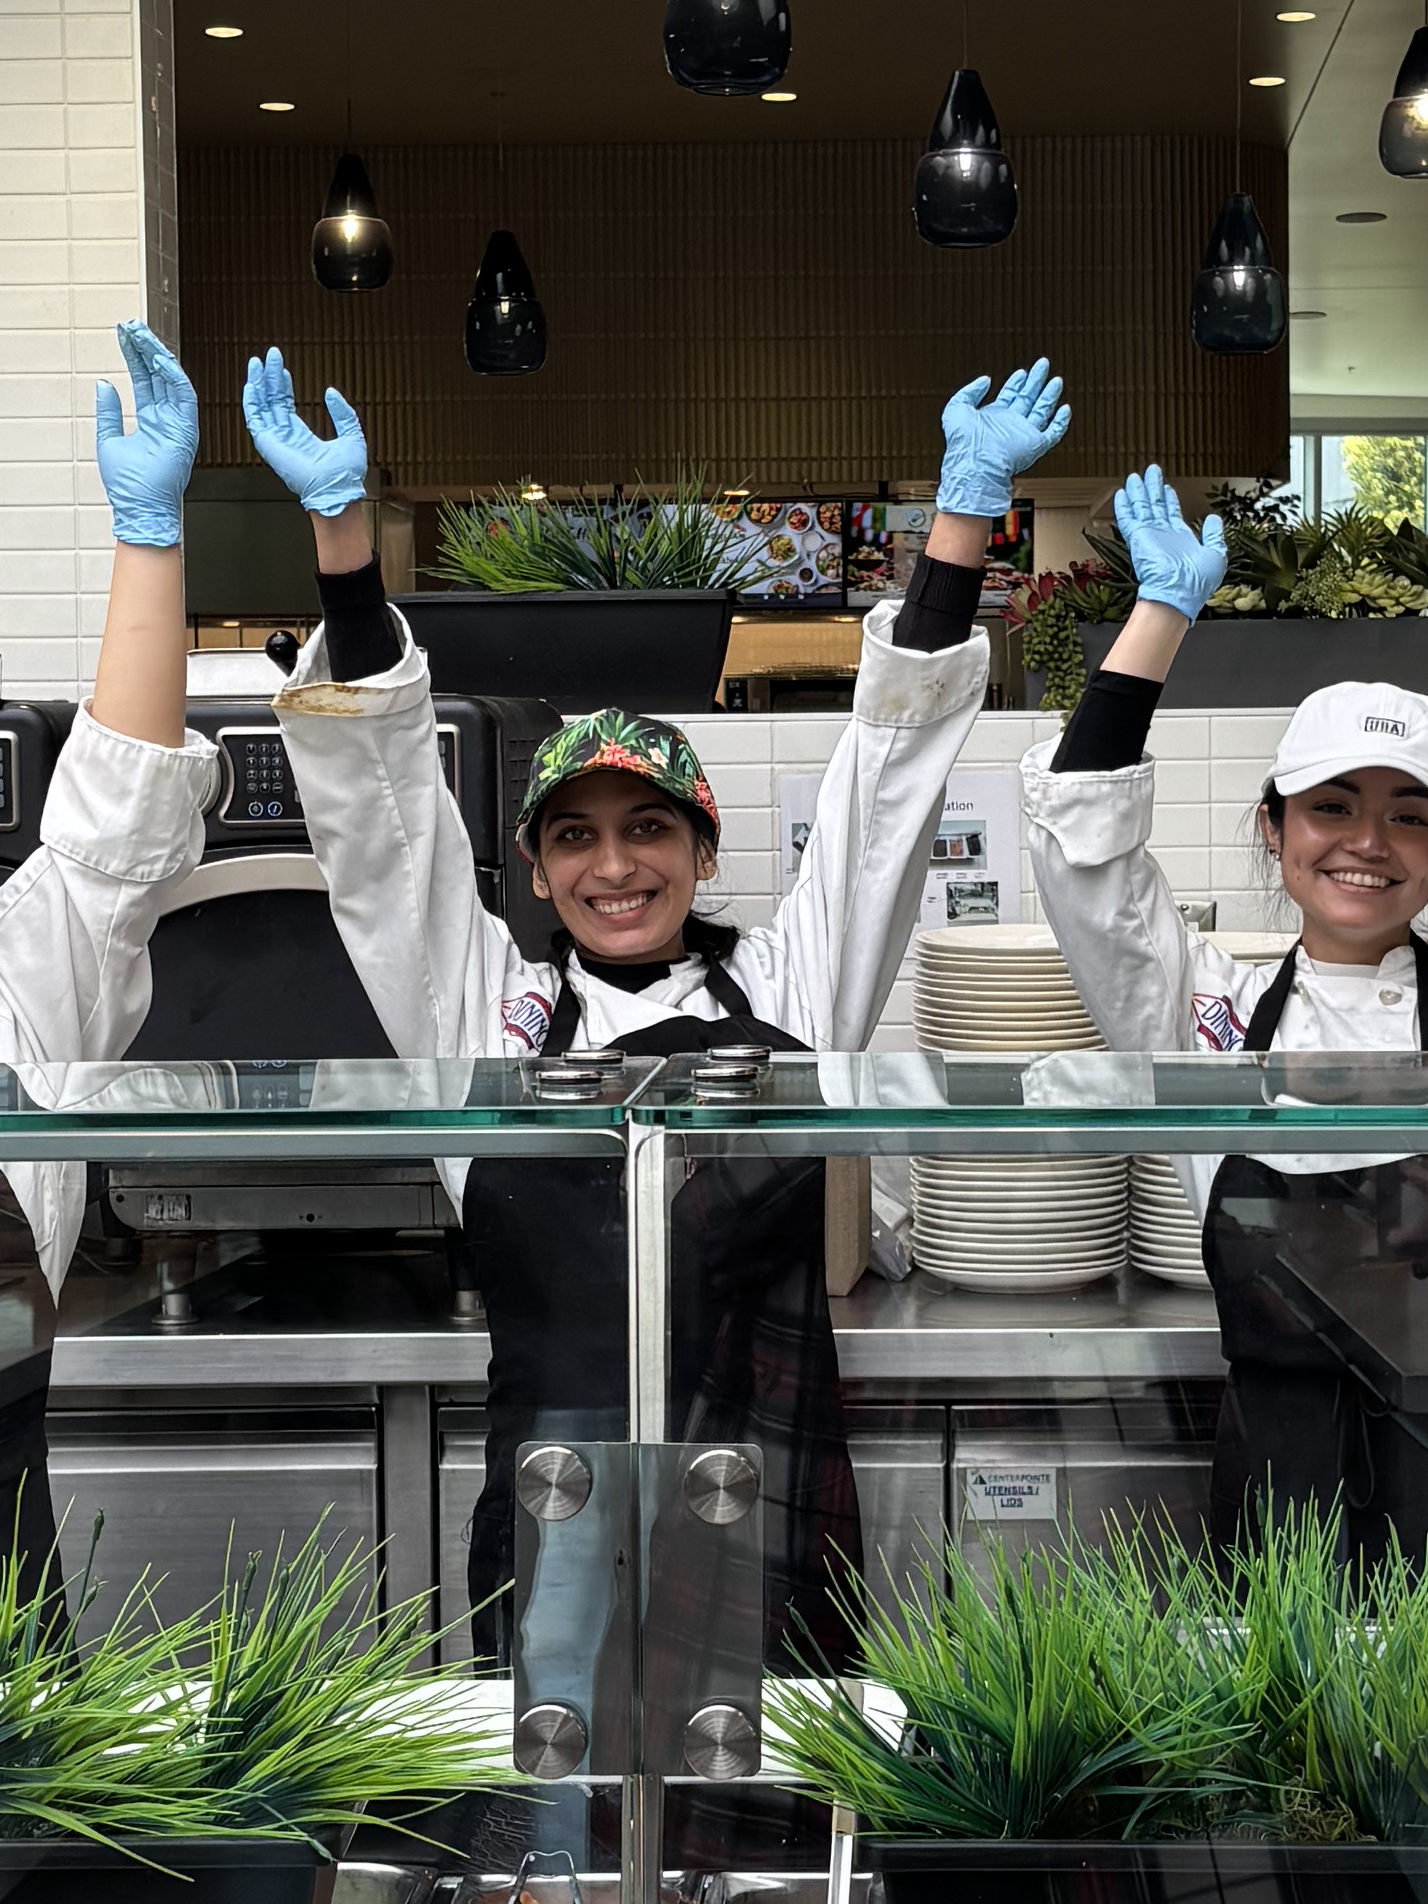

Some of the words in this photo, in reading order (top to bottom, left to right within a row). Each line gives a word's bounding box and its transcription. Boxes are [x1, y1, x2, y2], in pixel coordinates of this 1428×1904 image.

[944, 800, 974, 812] ation
[984, 1485, 1033, 1496] UTENSILS
[1000, 1497, 1024, 1508] LIDS
